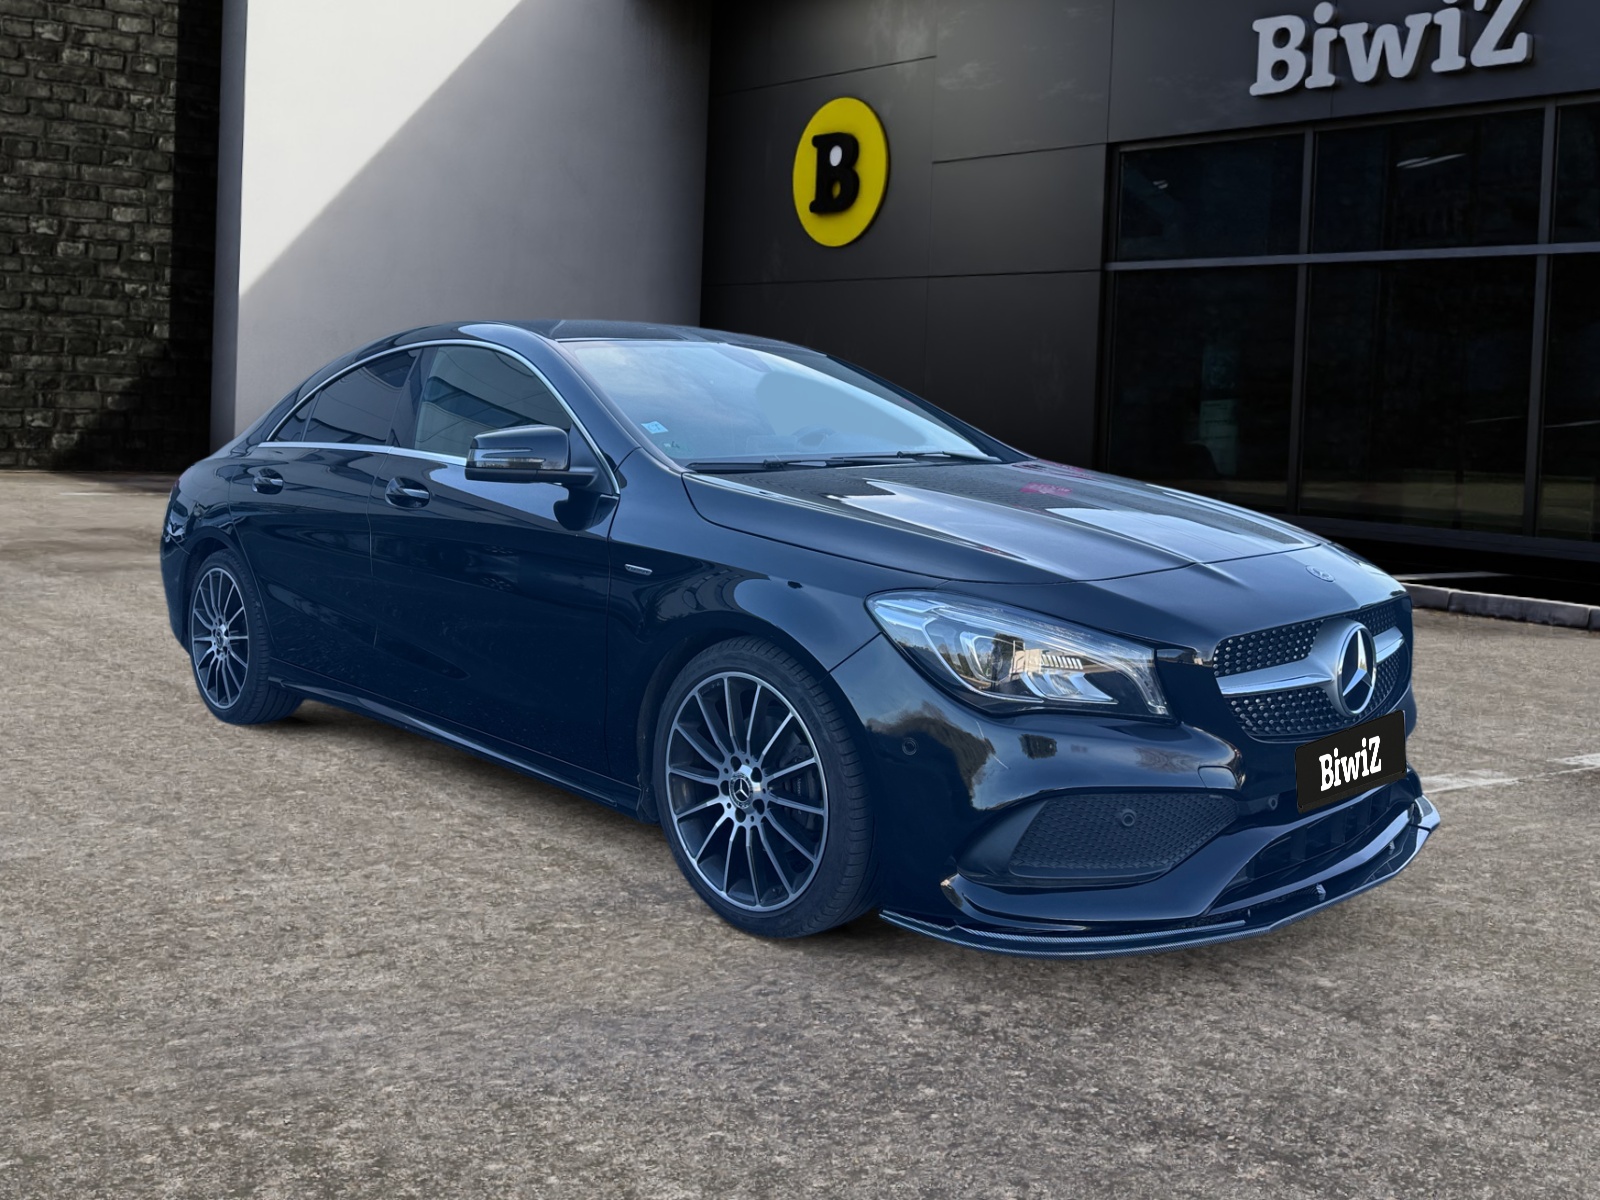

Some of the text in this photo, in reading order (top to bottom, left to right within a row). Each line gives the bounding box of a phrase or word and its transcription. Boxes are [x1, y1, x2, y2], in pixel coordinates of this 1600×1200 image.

[1249, 0, 1531, 96] BiwiZ
[809, 132, 860, 214] B
[1319, 735, 1382, 792] BiwiZ
